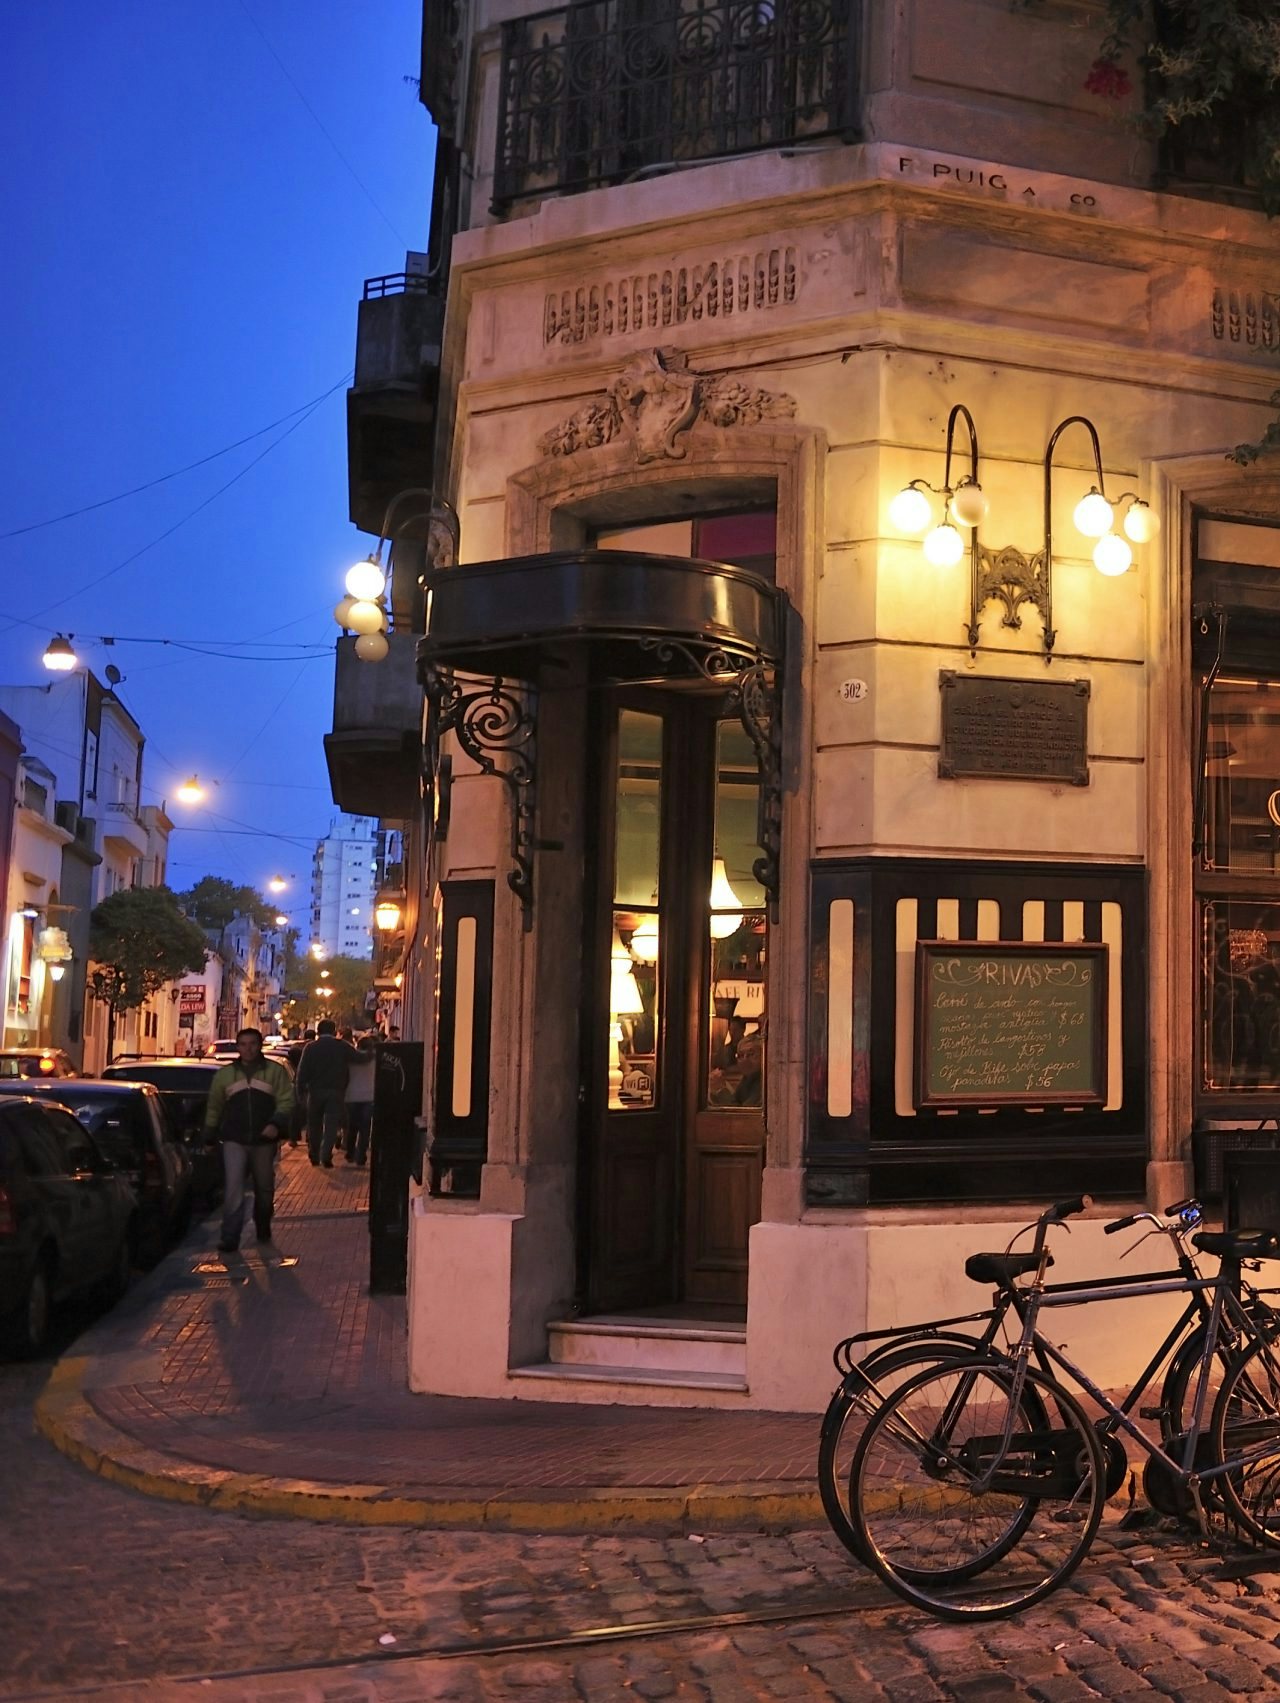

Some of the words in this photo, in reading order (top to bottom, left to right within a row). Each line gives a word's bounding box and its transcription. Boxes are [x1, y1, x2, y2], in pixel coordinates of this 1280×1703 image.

[899, 157, 912, 172] F
[933, 164, 1007, 190] PUIG
[1070, 193, 1096, 206] CO
[844, 682, 861, 699] 302
[985, 961, 1042, 988] RIVAS
